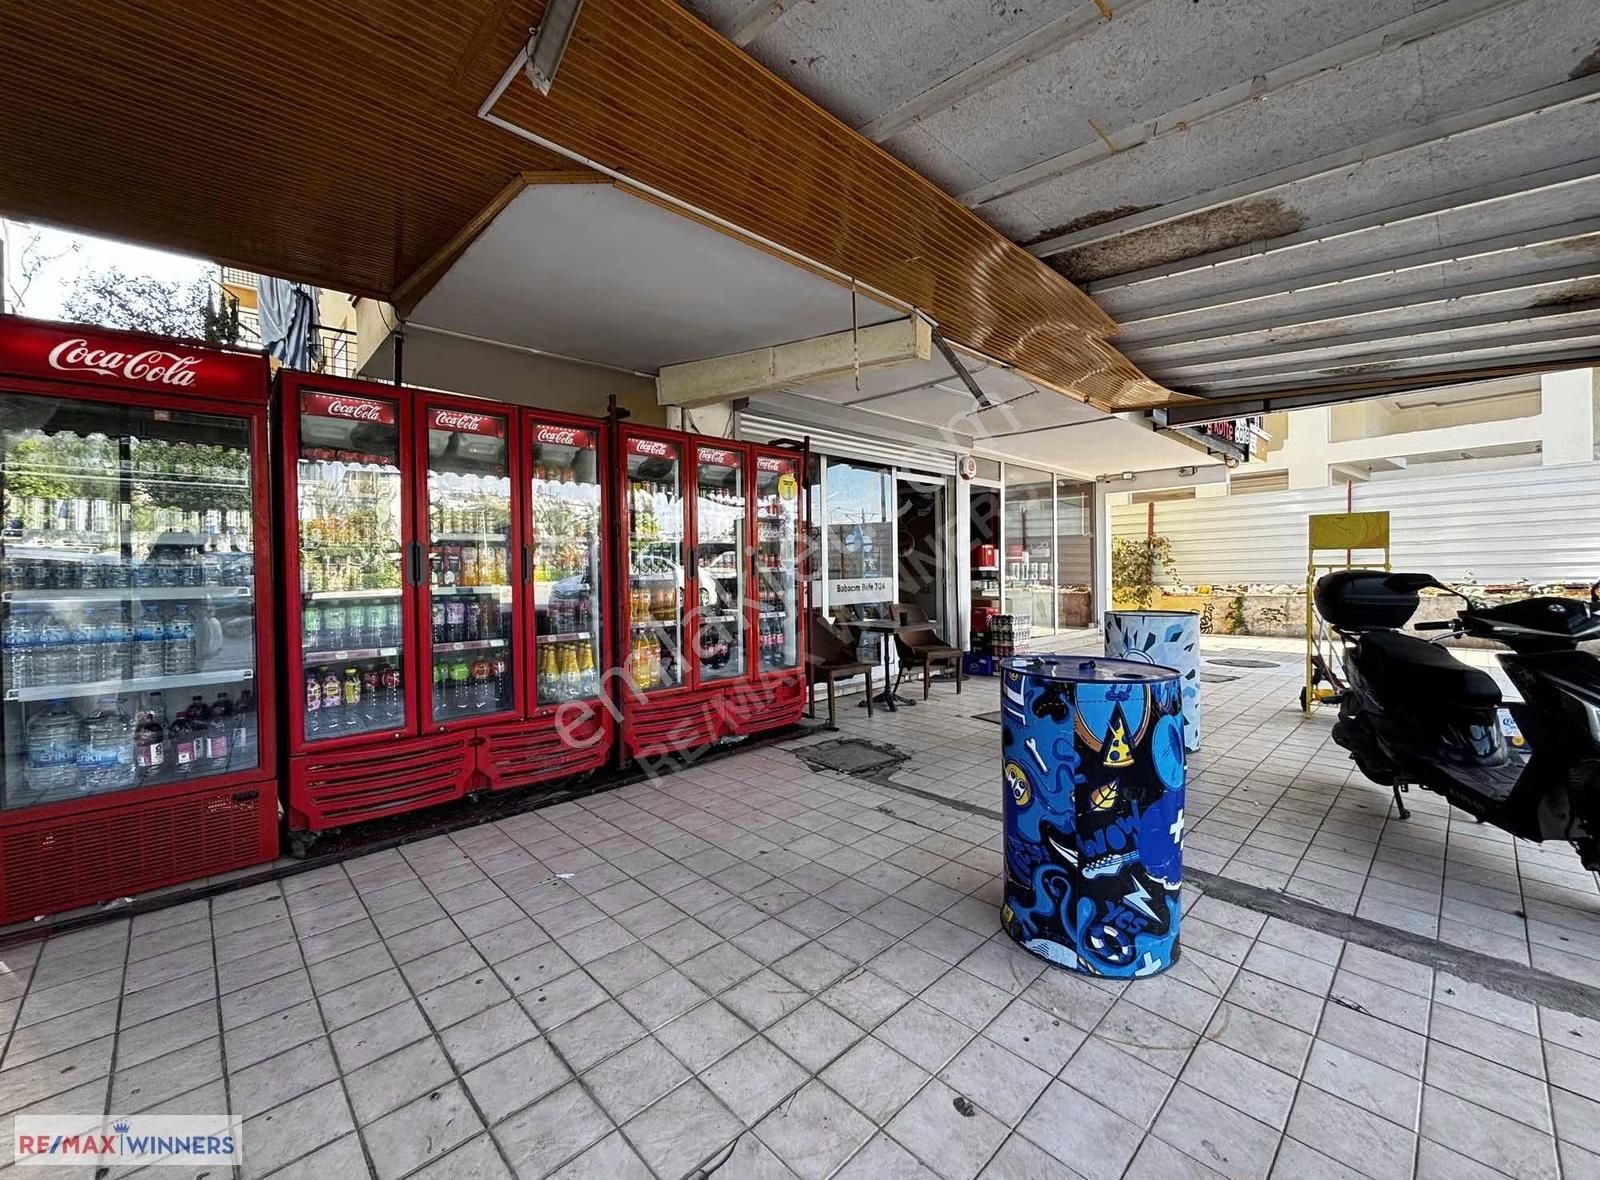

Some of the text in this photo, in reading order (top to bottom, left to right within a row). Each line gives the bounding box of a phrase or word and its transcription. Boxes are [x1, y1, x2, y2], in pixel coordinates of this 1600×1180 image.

[49, 338, 203, 386] Coca-Cola
[327, 400, 382, 421] Coca-Cola
[435, 411, 481, 431] Coca-Cola
[537, 429, 575, 445] Coca-Cola
[636, 440, 667, 456] Coca-Cola
[699, 450, 725, 464] Coca-Cola
[757, 458, 782, 471] Coca-Cola
